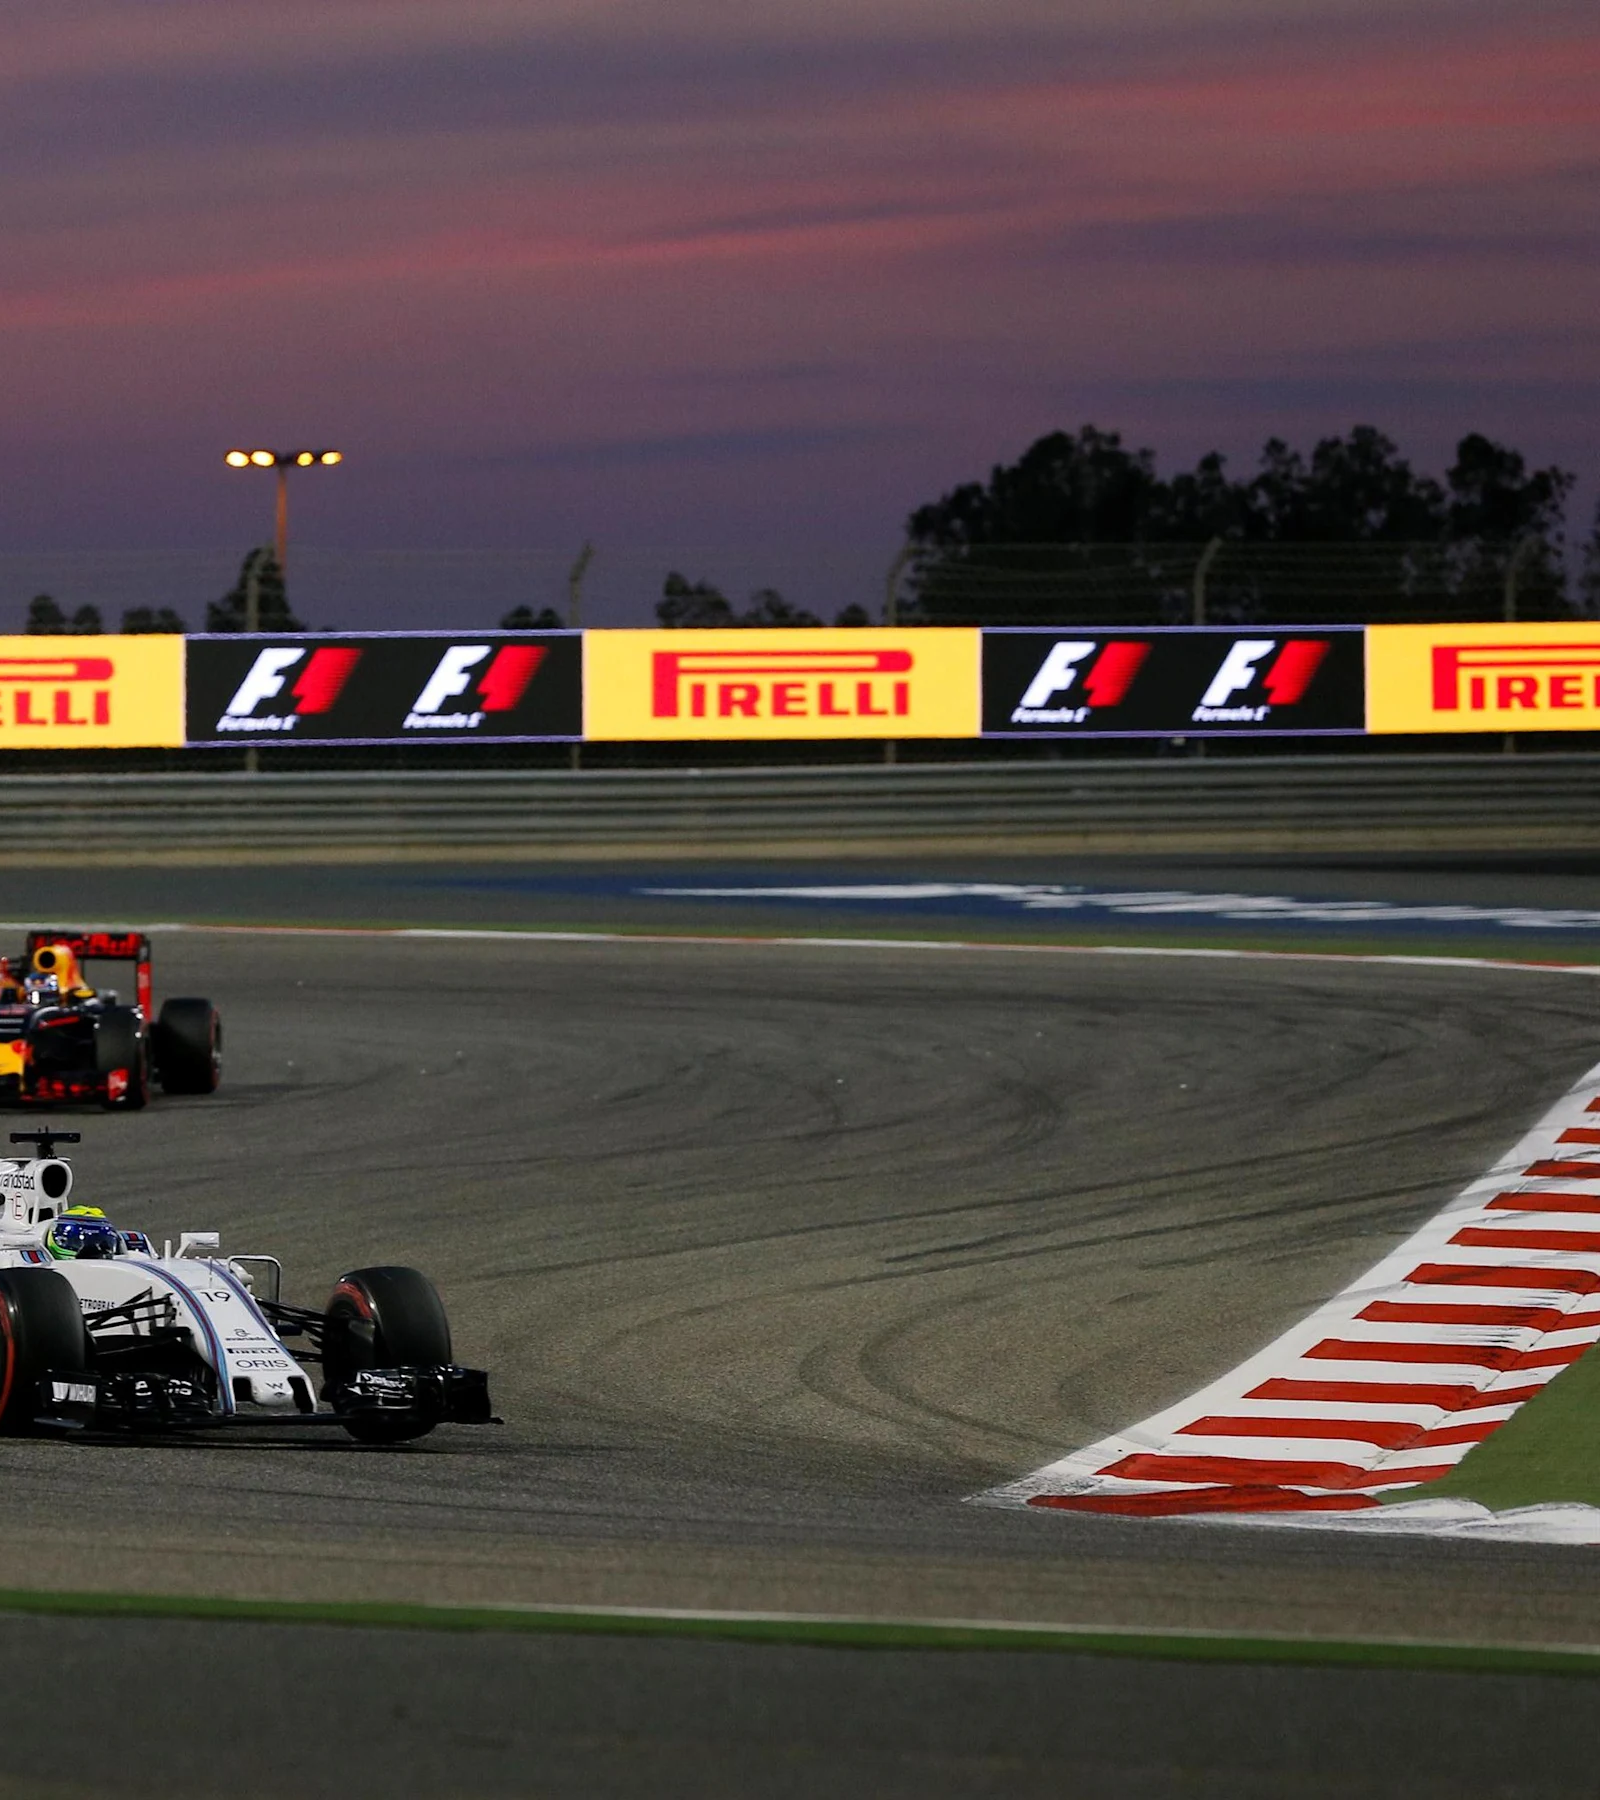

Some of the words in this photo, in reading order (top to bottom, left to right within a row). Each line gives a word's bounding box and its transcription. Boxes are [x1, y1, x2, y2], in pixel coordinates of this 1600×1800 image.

[225, 647, 364, 715] F1
[411, 644, 550, 713] F1
[652, 650, 914, 717] PIRELLI
[1019, 641, 1152, 707] F1
[1200, 640, 1330, 706] F1
[0, 1171, 35, 1190] randstad
[78, 1298, 116, 1311] ETROBRAS
[201, 1291, 231, 1302] 19
[236, 1359, 288, 1368] ORIS
